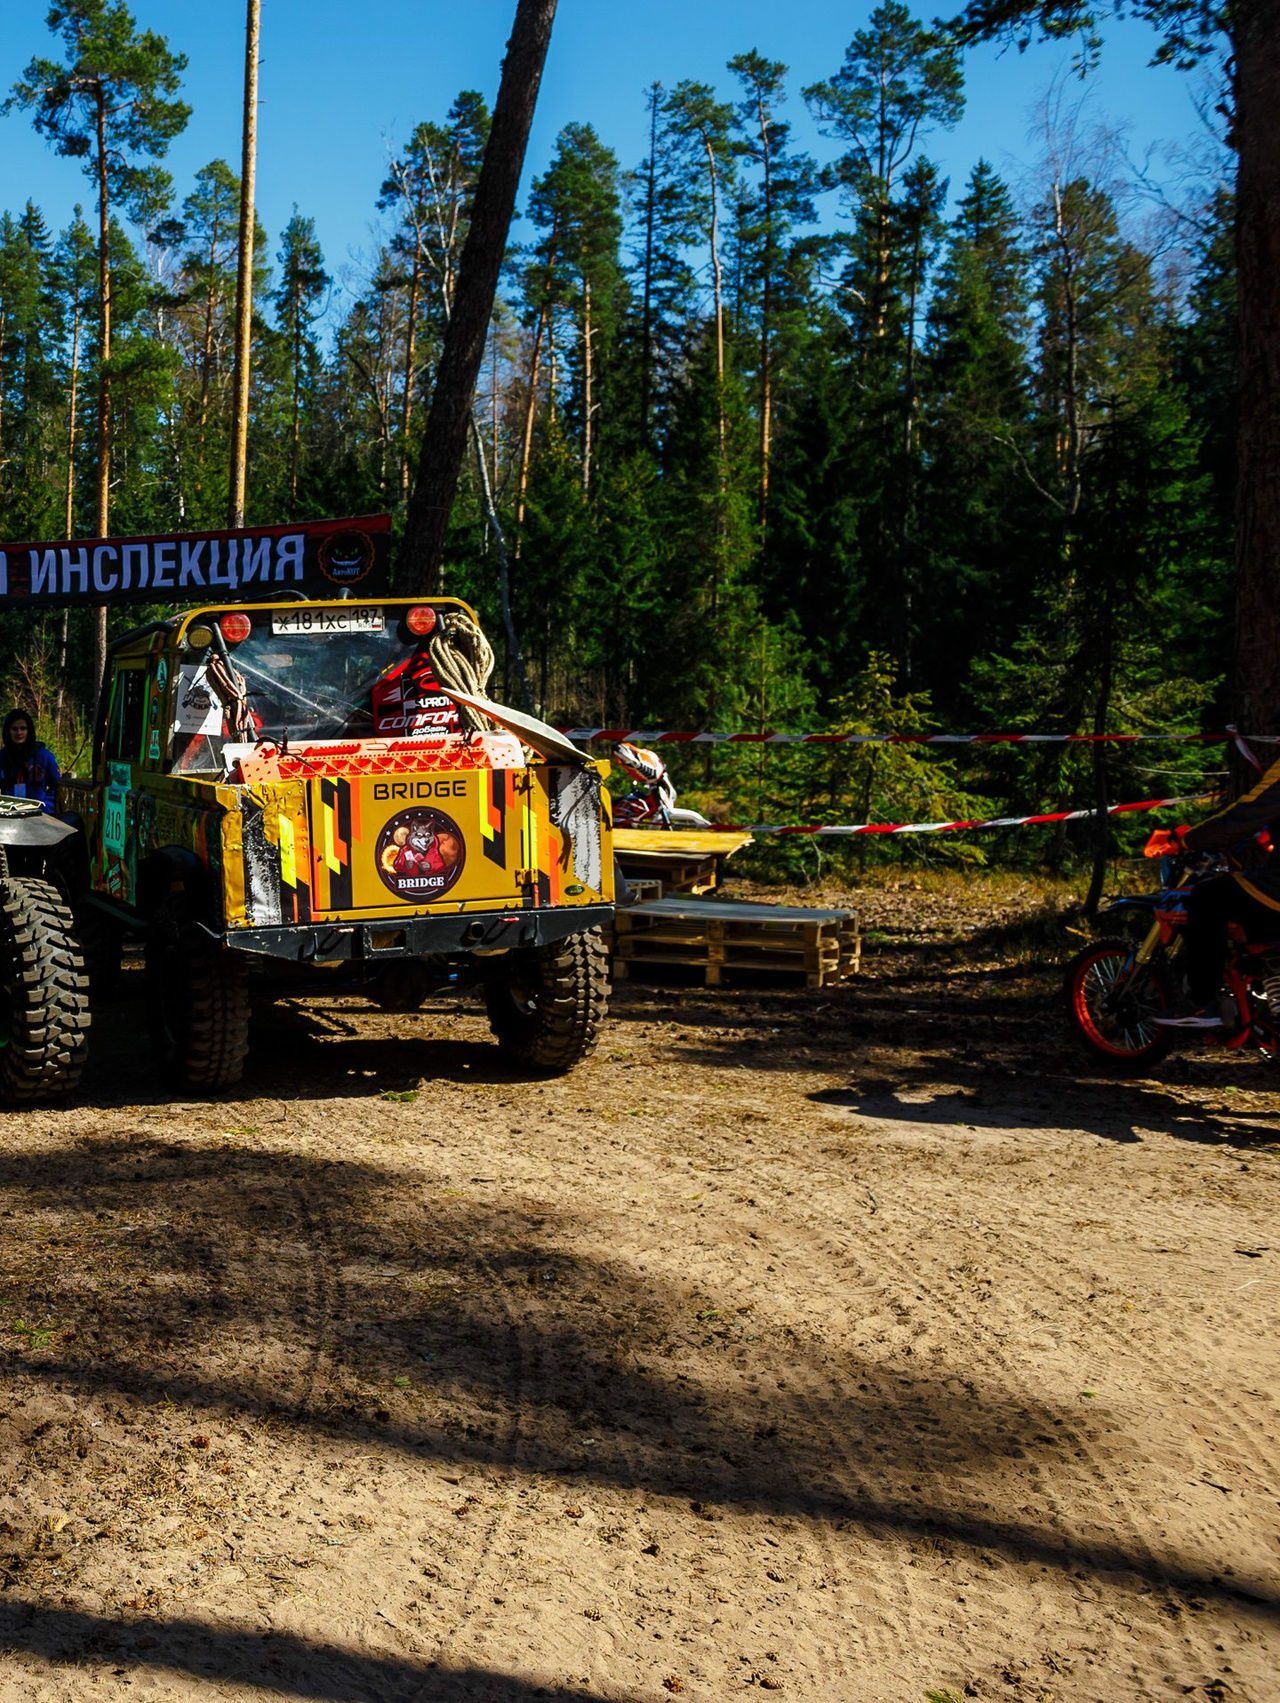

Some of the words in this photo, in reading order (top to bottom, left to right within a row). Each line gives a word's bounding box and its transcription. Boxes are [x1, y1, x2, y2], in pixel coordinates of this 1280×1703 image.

[29, 534, 305, 595] ИНСПЕКЦИЯ
[352, 609, 378, 624] 197
[414, 696, 454, 709] SUPROT
[379, 711, 458, 730] COMFOR
[374, 780, 467, 800] BRIDGE
[105, 809, 121, 842] 216
[398, 876, 445, 889] BRIDGE
